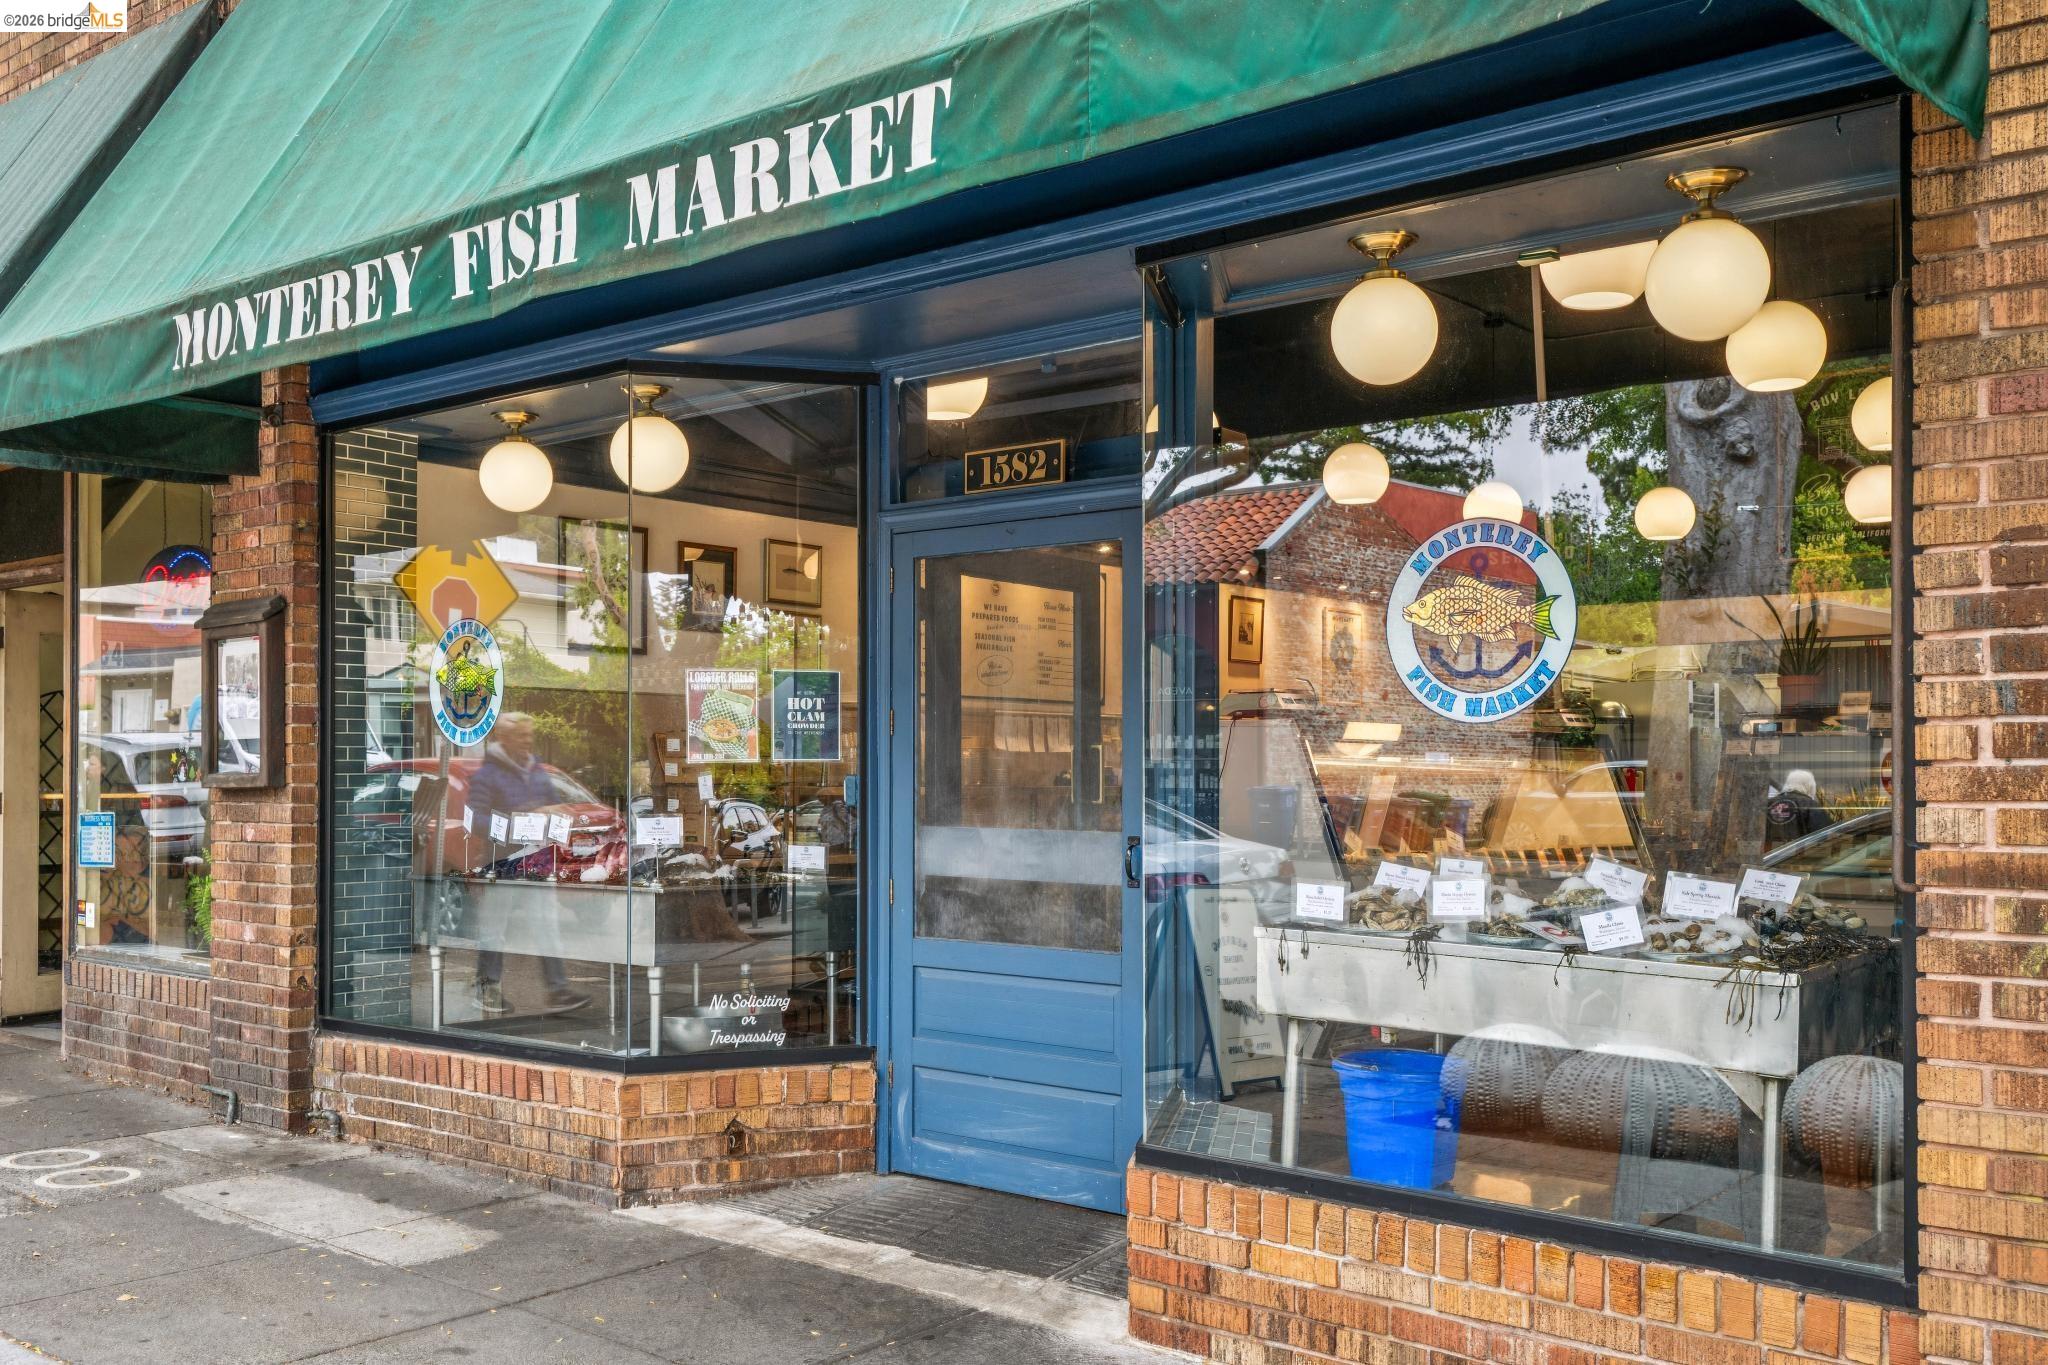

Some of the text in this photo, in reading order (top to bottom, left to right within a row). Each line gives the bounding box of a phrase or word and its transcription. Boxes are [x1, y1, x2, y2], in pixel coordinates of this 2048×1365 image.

[172, 78, 952, 371] MONTEREY FISH MARKET
[980, 449, 1047, 487] 1582
[1410, 523, 1549, 577] MONTEREY
[439, 620, 493, 653] MONTEREY
[689, 672, 755, 682] LOBSTER ROLLS
[1406, 659, 1556, 717] FISH MARKET
[787, 697, 825, 710] HOT
[436, 708, 496, 743] FISH MARKET
[787, 711, 825, 722] CLAM
[709, 994, 791, 1011] No Soliciting
[742, 1016, 757, 1025] or
[709, 1030, 786, 1048] Trespassing
